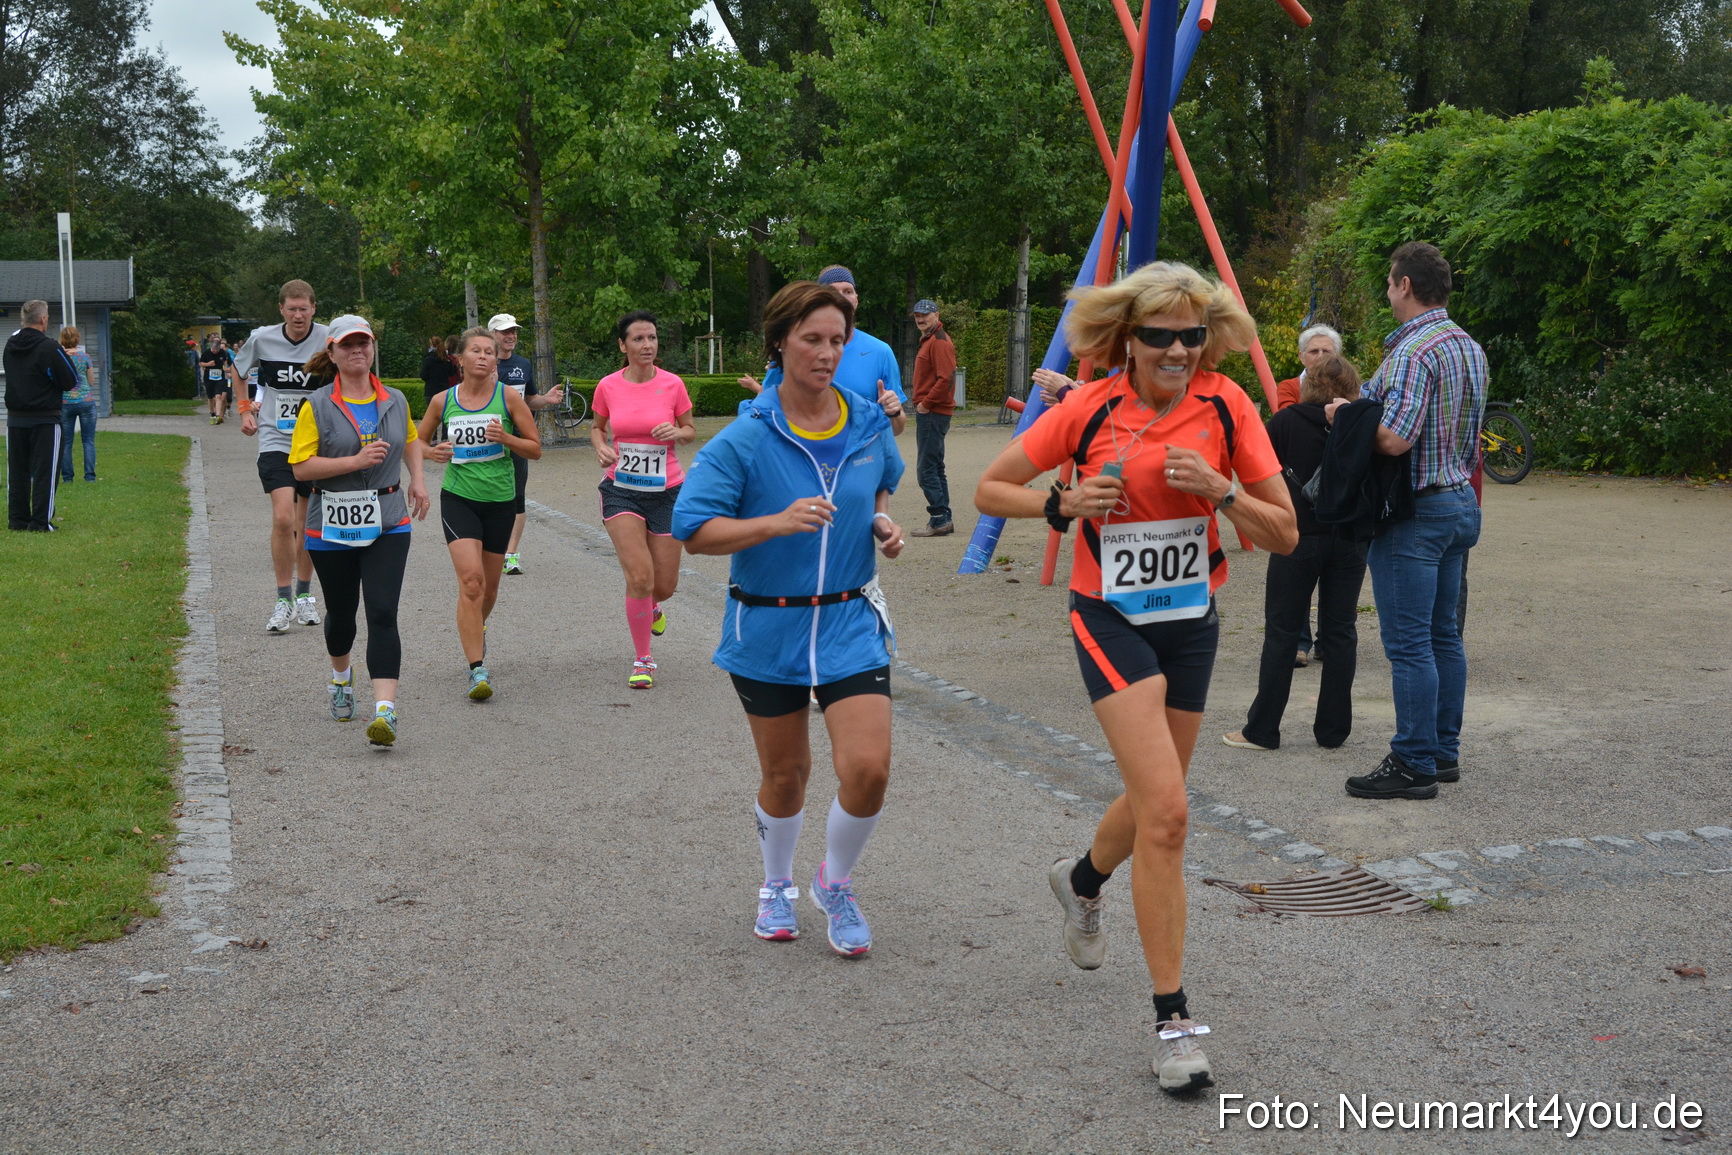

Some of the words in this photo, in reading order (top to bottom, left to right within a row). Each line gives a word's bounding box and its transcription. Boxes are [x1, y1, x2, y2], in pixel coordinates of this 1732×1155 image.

[277, 365, 312, 387] sky
[454, 426, 494, 445] 289
[466, 448, 489, 457] Gisela
[620, 454, 660, 474] 2211
[626, 476, 653, 486] Martina
[327, 504, 375, 526] 2082
[340, 530, 361, 540] Birgit
[1103, 533, 1141, 545] PARTL
[1143, 528, 1191, 542] Neumarkt
[1114, 542, 1199, 587] 2902
[1143, 594, 1171, 610] Jina
